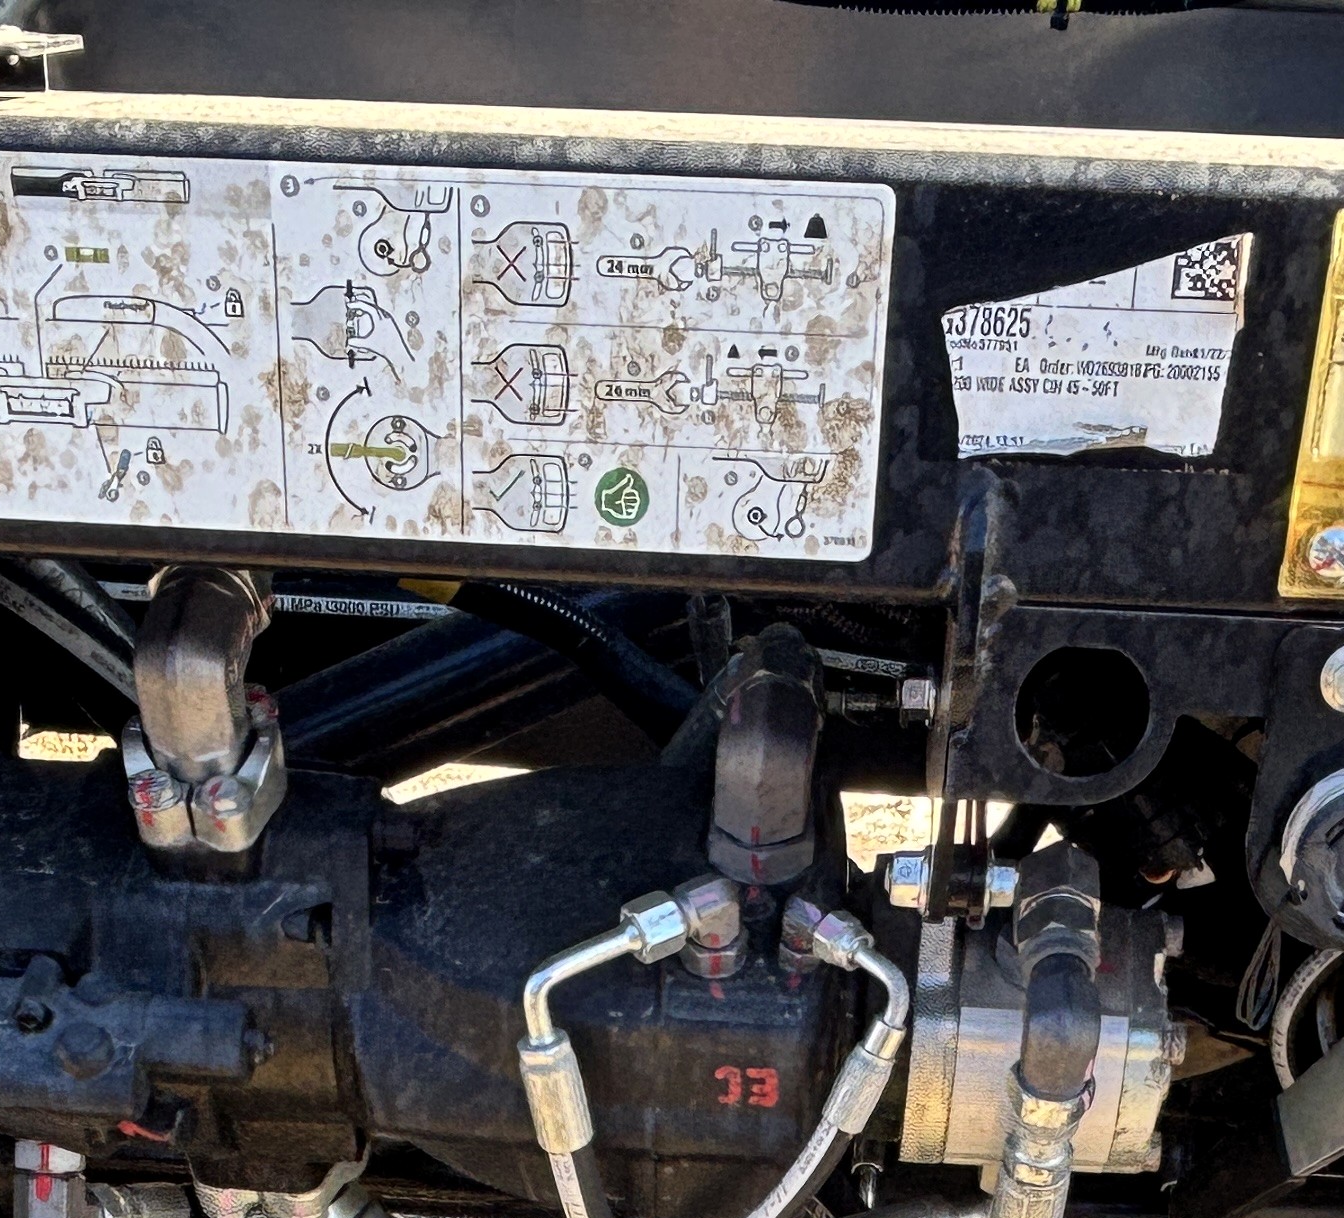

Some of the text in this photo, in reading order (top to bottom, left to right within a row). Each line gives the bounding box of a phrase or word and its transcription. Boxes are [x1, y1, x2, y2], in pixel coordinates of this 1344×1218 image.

[627, 263, 654, 275] mm
[1015, 358, 1030, 374] EA
[1040, 358, 1074, 376] Order:
[625, 386, 651, 398] mm
[1009, 377, 1039, 394] ASSY
[290, 597, 322, 613] MPa
